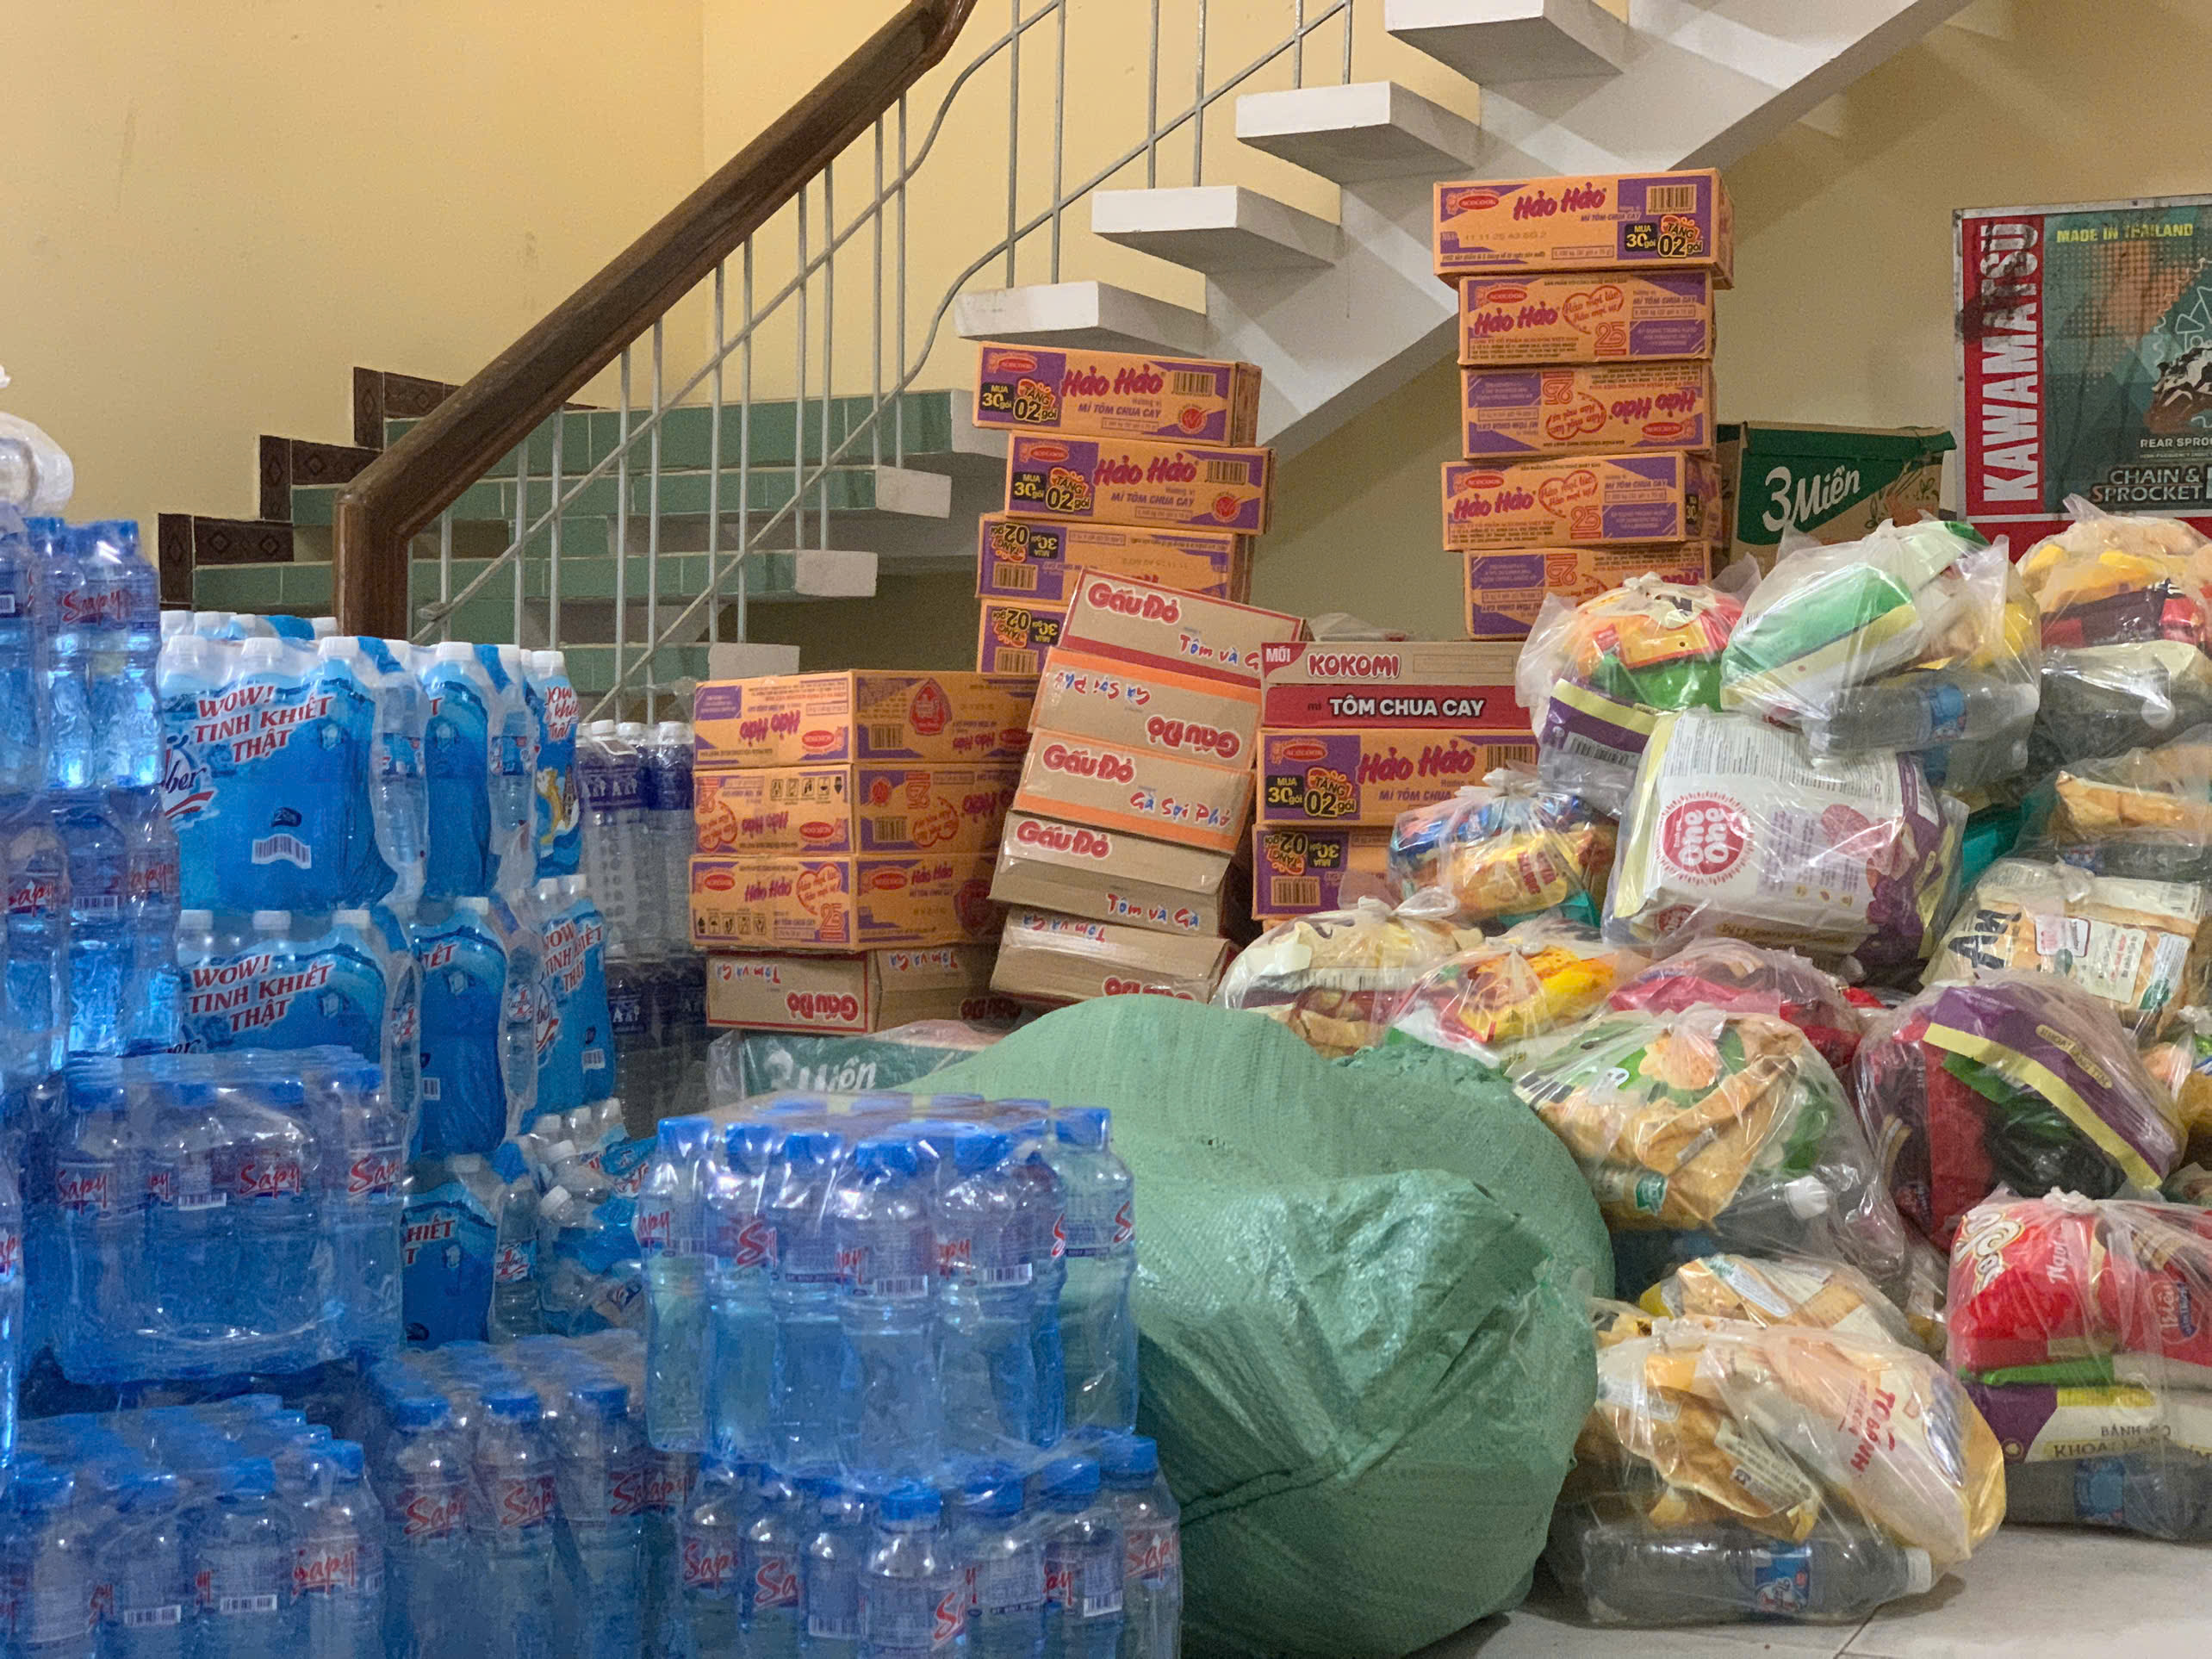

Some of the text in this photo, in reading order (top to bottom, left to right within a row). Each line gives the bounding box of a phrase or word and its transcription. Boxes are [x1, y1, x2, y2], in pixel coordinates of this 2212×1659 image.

[1513, 182, 1606, 221] Hảo Hảo
[1626, 233, 1647, 247] 30
[1659, 235, 1686, 256] 02
[2057, 229, 2098, 243] MADE
[2103, 227, 2119, 240] IN
[1475, 301, 1558, 334] Hảo Hảo
[1060, 363, 1164, 397] Hảo Hảo
[982, 393, 1004, 407] 30
[1015, 399, 1041, 421] 02
[1611, 390, 1695, 424] Hảo Hảo
[2140, 437, 2212, 448] REAR SPRO
[1022, 474, 1041, 482] MUA
[1093, 452, 1196, 486] Hảo Hảo
[2109, 469, 2200, 484] CHAIN &
[1014, 482, 1036, 496] 30
[1047, 488, 1074, 510] 02
[1762, 464, 1861, 532] 3 Miền
[2092, 486, 2203, 502] SPROCKET
[1454, 487, 1534, 519] Hảo Hảo
[1005, 525, 1028, 545] 02
[1007, 610, 1030, 631] 02
[1179, 634, 1259, 670] Tôm và G
[1266, 646, 1290, 662] MỚI
[1308, 654, 1401, 678] KOKOMI
[199, 686, 275, 718] WOW!
[1329, 695, 1375, 716] TÔM
[1379, 699, 1438, 717] CHUA
[1443, 699, 1484, 717] CAY
[195, 691, 334, 743] TINH KHIẾT
[233, 727, 293, 764] THẬT
[1357, 739, 1476, 784] Hảo Hảo
[1277, 778, 1297, 786] MUA
[1268, 787, 1291, 804] 30
[1307, 791, 1337, 814] 02
[1130, 792, 1154, 811] Gà
[1196, 803, 1231, 827] Phở
[1281, 833, 1307, 854] 02
[1108, 893, 1199, 928] Tôm và Gà
[193, 954, 271, 989] WOW!
[189, 961, 334, 1014] TINH KHIẾT
[229, 997, 291, 1033] THẬT
[238, 1159, 301, 1199] Sapy
